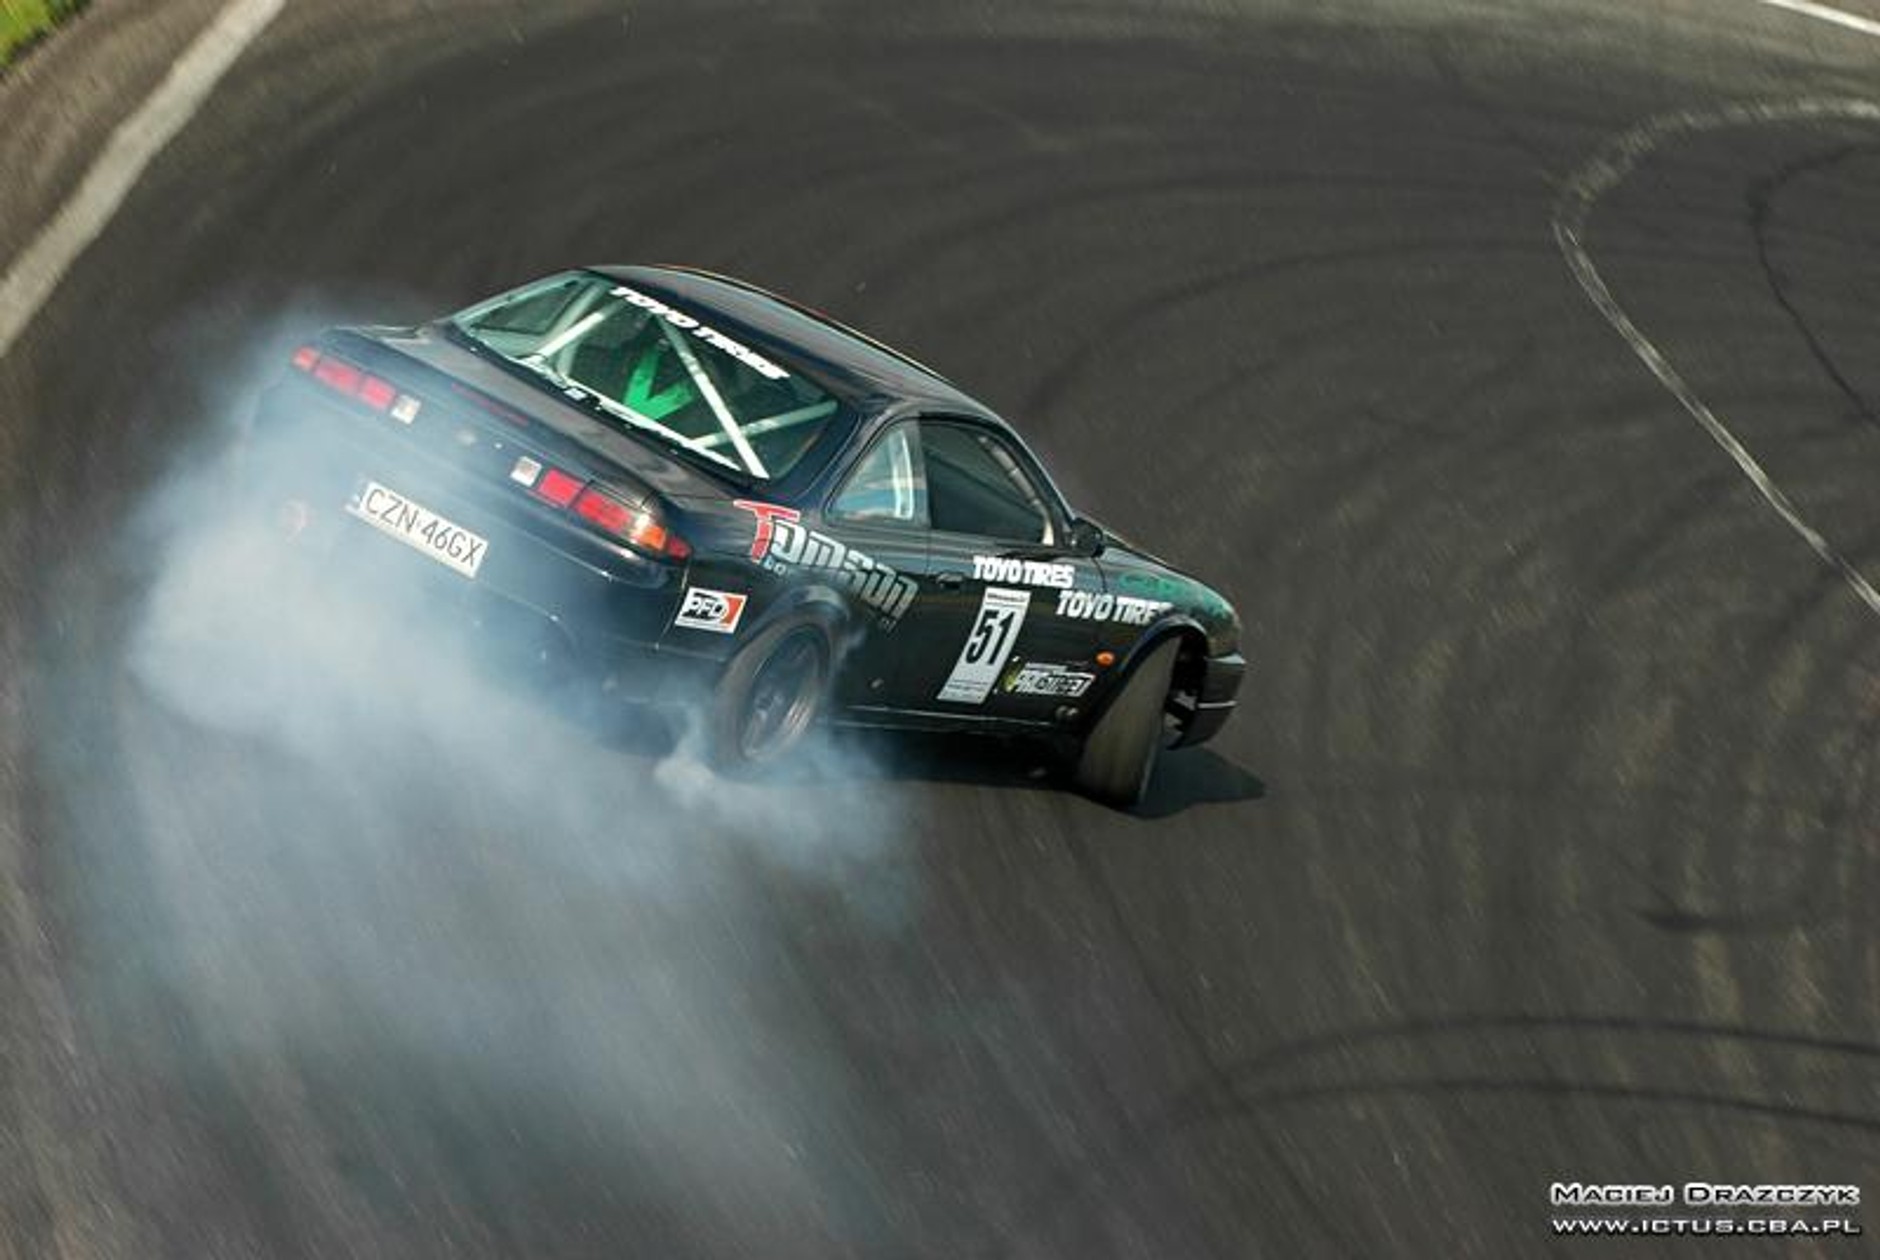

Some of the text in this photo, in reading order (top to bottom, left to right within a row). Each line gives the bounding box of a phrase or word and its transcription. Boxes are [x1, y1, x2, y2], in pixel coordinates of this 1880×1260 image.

[972, 555, 1075, 589] TOYO TIRES
[1055, 589, 1115, 622] TOYO
[966, 609, 1015, 666] 51
